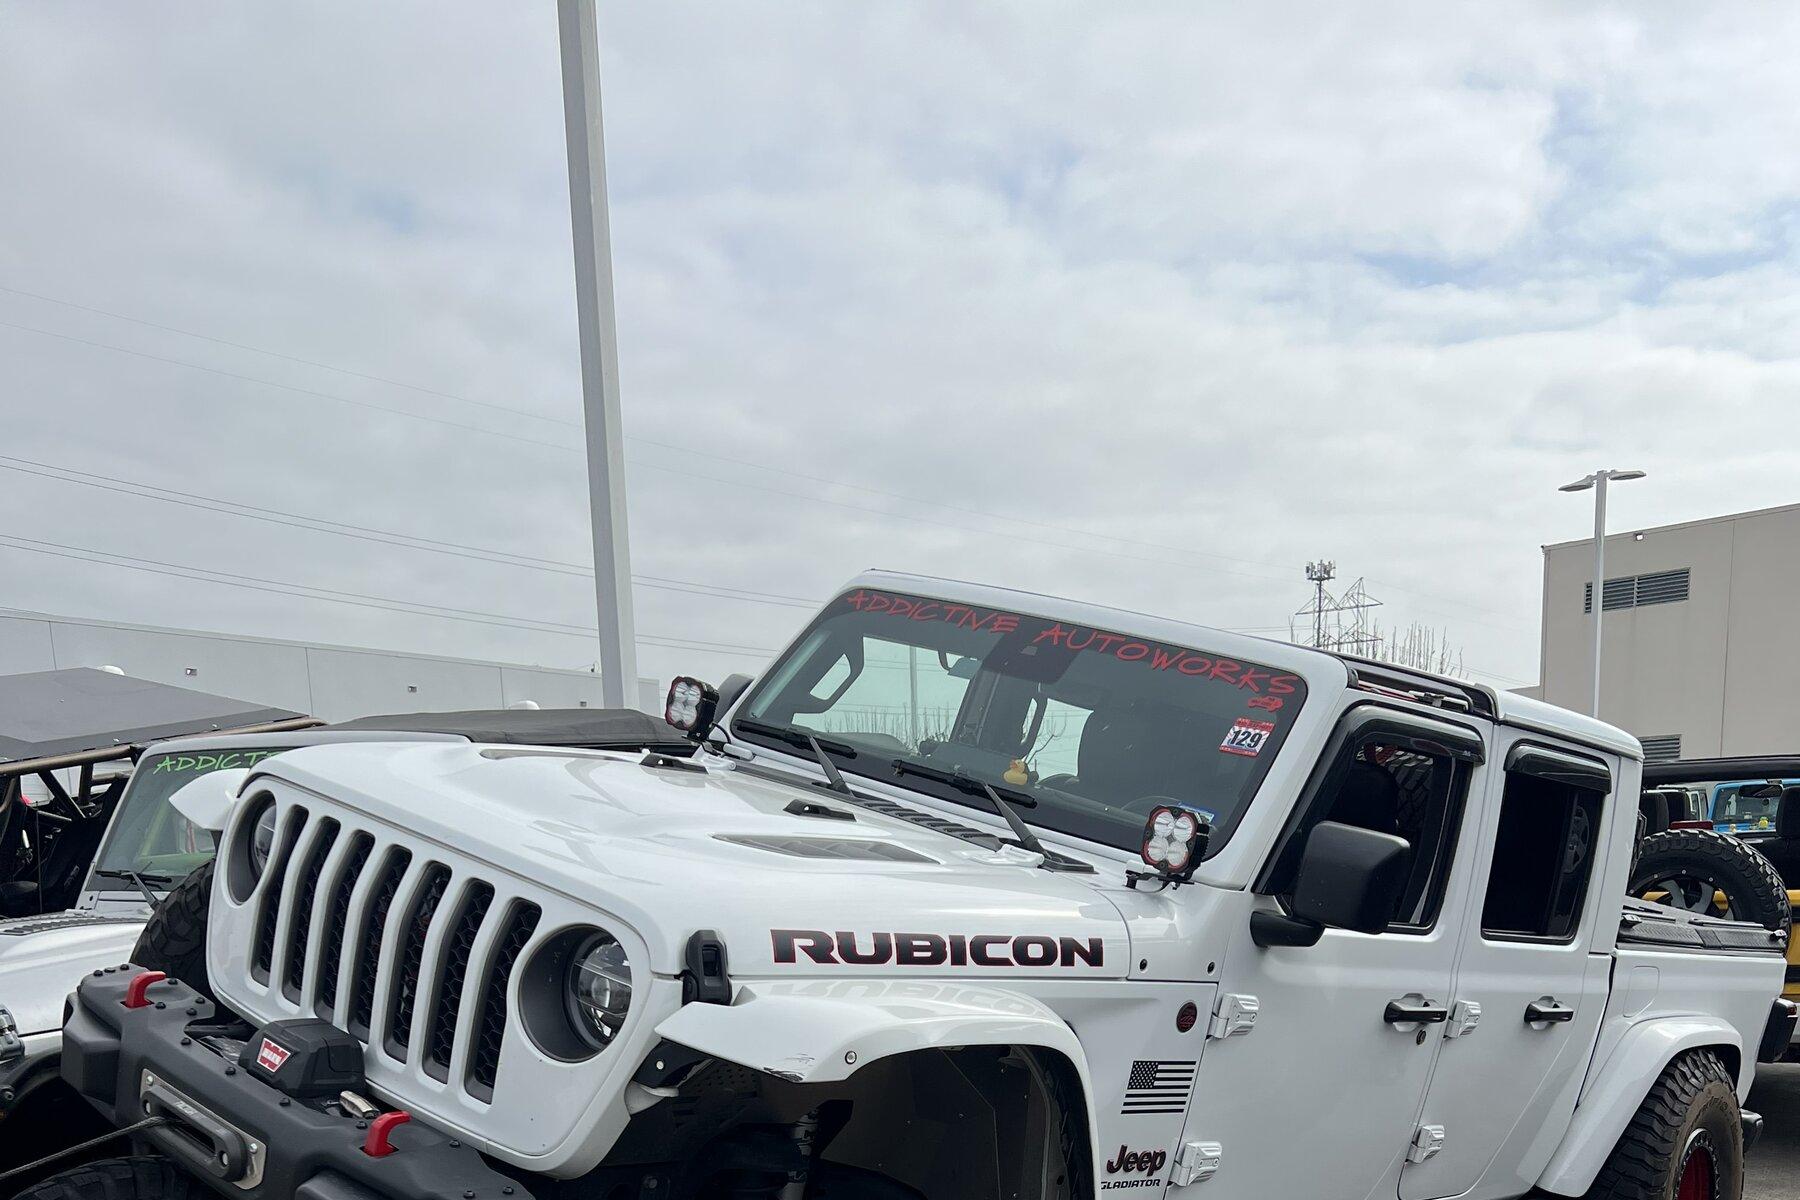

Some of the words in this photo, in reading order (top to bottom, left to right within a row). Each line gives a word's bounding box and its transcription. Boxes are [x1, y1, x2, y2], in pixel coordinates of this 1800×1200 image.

[847, 590, 1020, 634] ADDICTIVE
[1033, 623, 1299, 694] AUTOWORKS
[1230, 730, 1263, 748] 129
[152, 751, 278, 775] ADDICT
[769, 928, 1104, 967] RUBICON
[1106, 1144, 1166, 1177] Jeep
[1100, 1178, 1161, 1190] GLADIATOR
